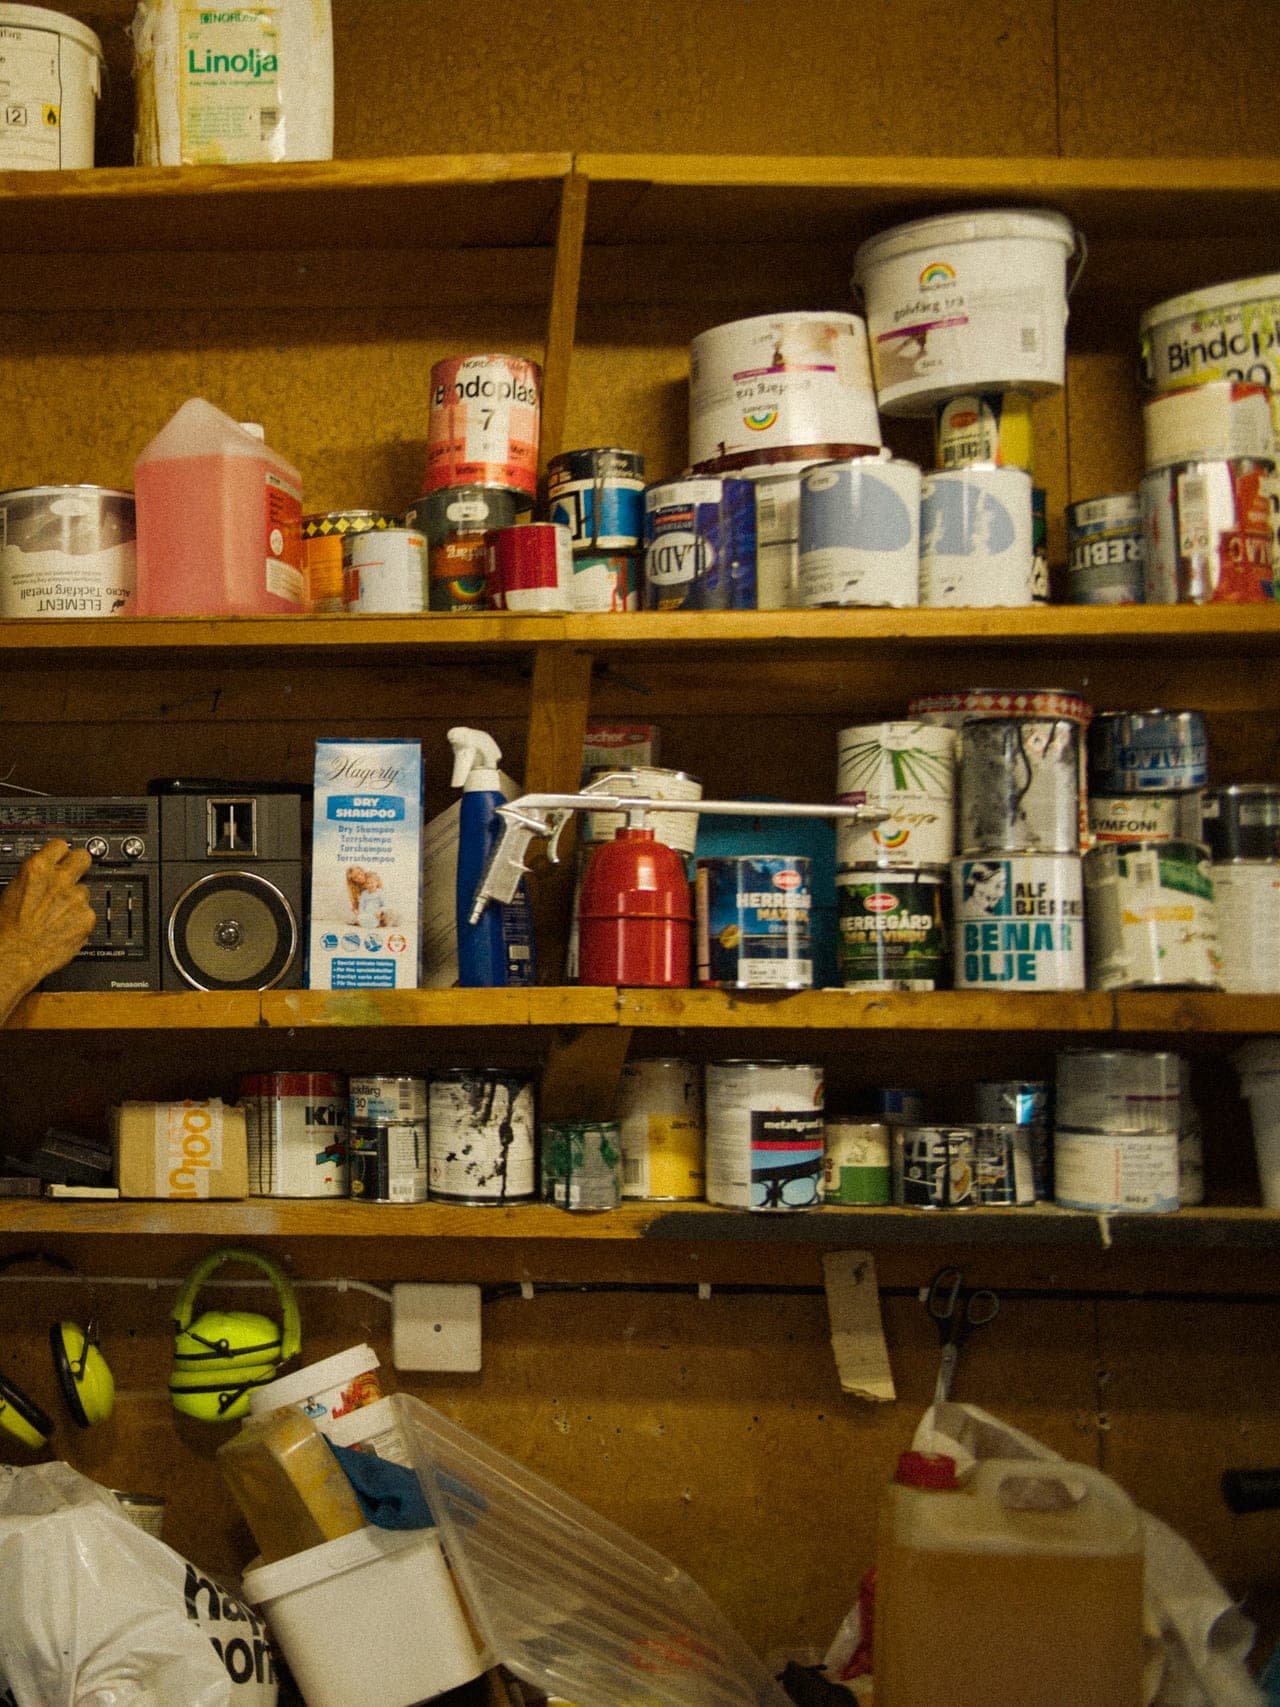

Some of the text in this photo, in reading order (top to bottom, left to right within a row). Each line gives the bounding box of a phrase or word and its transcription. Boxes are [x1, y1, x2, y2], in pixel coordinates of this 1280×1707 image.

[189, 48, 279, 77] Linolja
[12, 109, 22, 123] 2
[436, 375, 536, 406] Bndoplas
[481, 409, 496, 431] 7
[20, 584, 102, 600] metall Täckfärg
[37, 598, 101, 612] ELEMENT
[328, 756, 399, 790] Hagerty
[353, 797, 380, 807] DRY
[335, 808, 396, 818] SHAMPOO
[338, 825, 353, 833] Dry
[1089, 818, 1157, 832] SYMFONI
[1015, 882, 1047, 898] ALF
[965, 923, 1072, 951] BENAR
[965, 954, 1036, 982] OLJE
[111, 980, 150, 989] Panasonic
